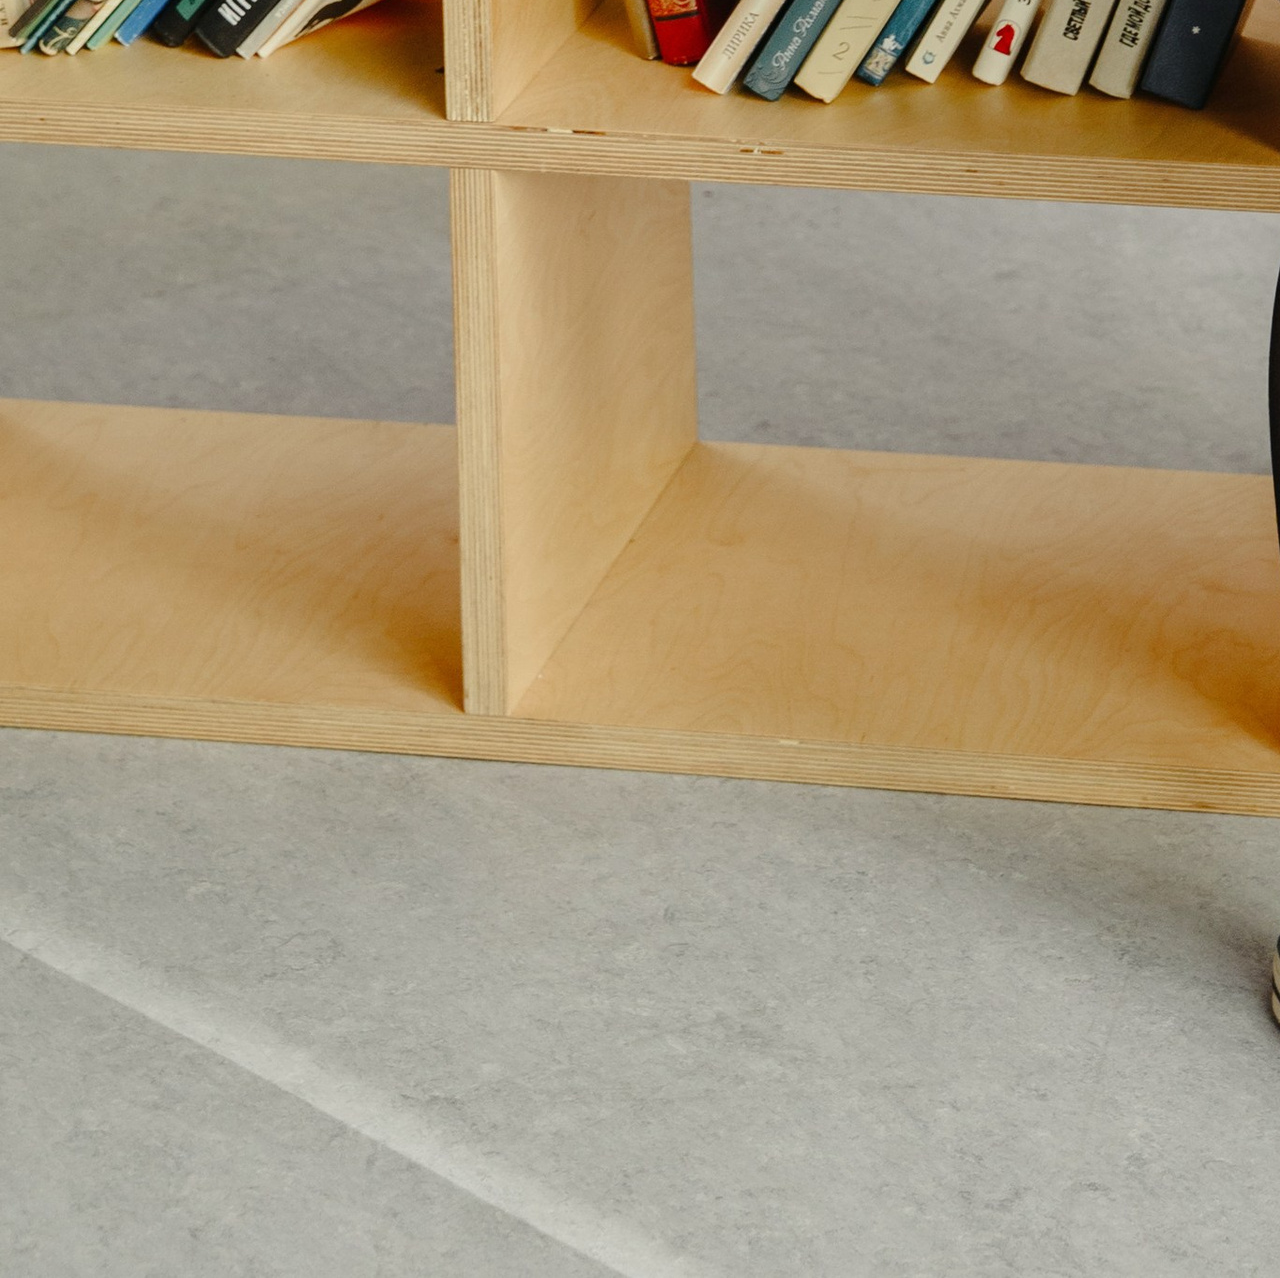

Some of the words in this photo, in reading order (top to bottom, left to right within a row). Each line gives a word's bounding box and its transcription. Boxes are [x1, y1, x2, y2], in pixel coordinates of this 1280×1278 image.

[1125, 6, 1145, 31] МОЙ
[722, 11, 760, 60] ЛИРИКА
[1119, 27, 1139, 48] ГДЕ
[772, 36, 803, 71] Анна
[832, 41, 850, 61] 2
